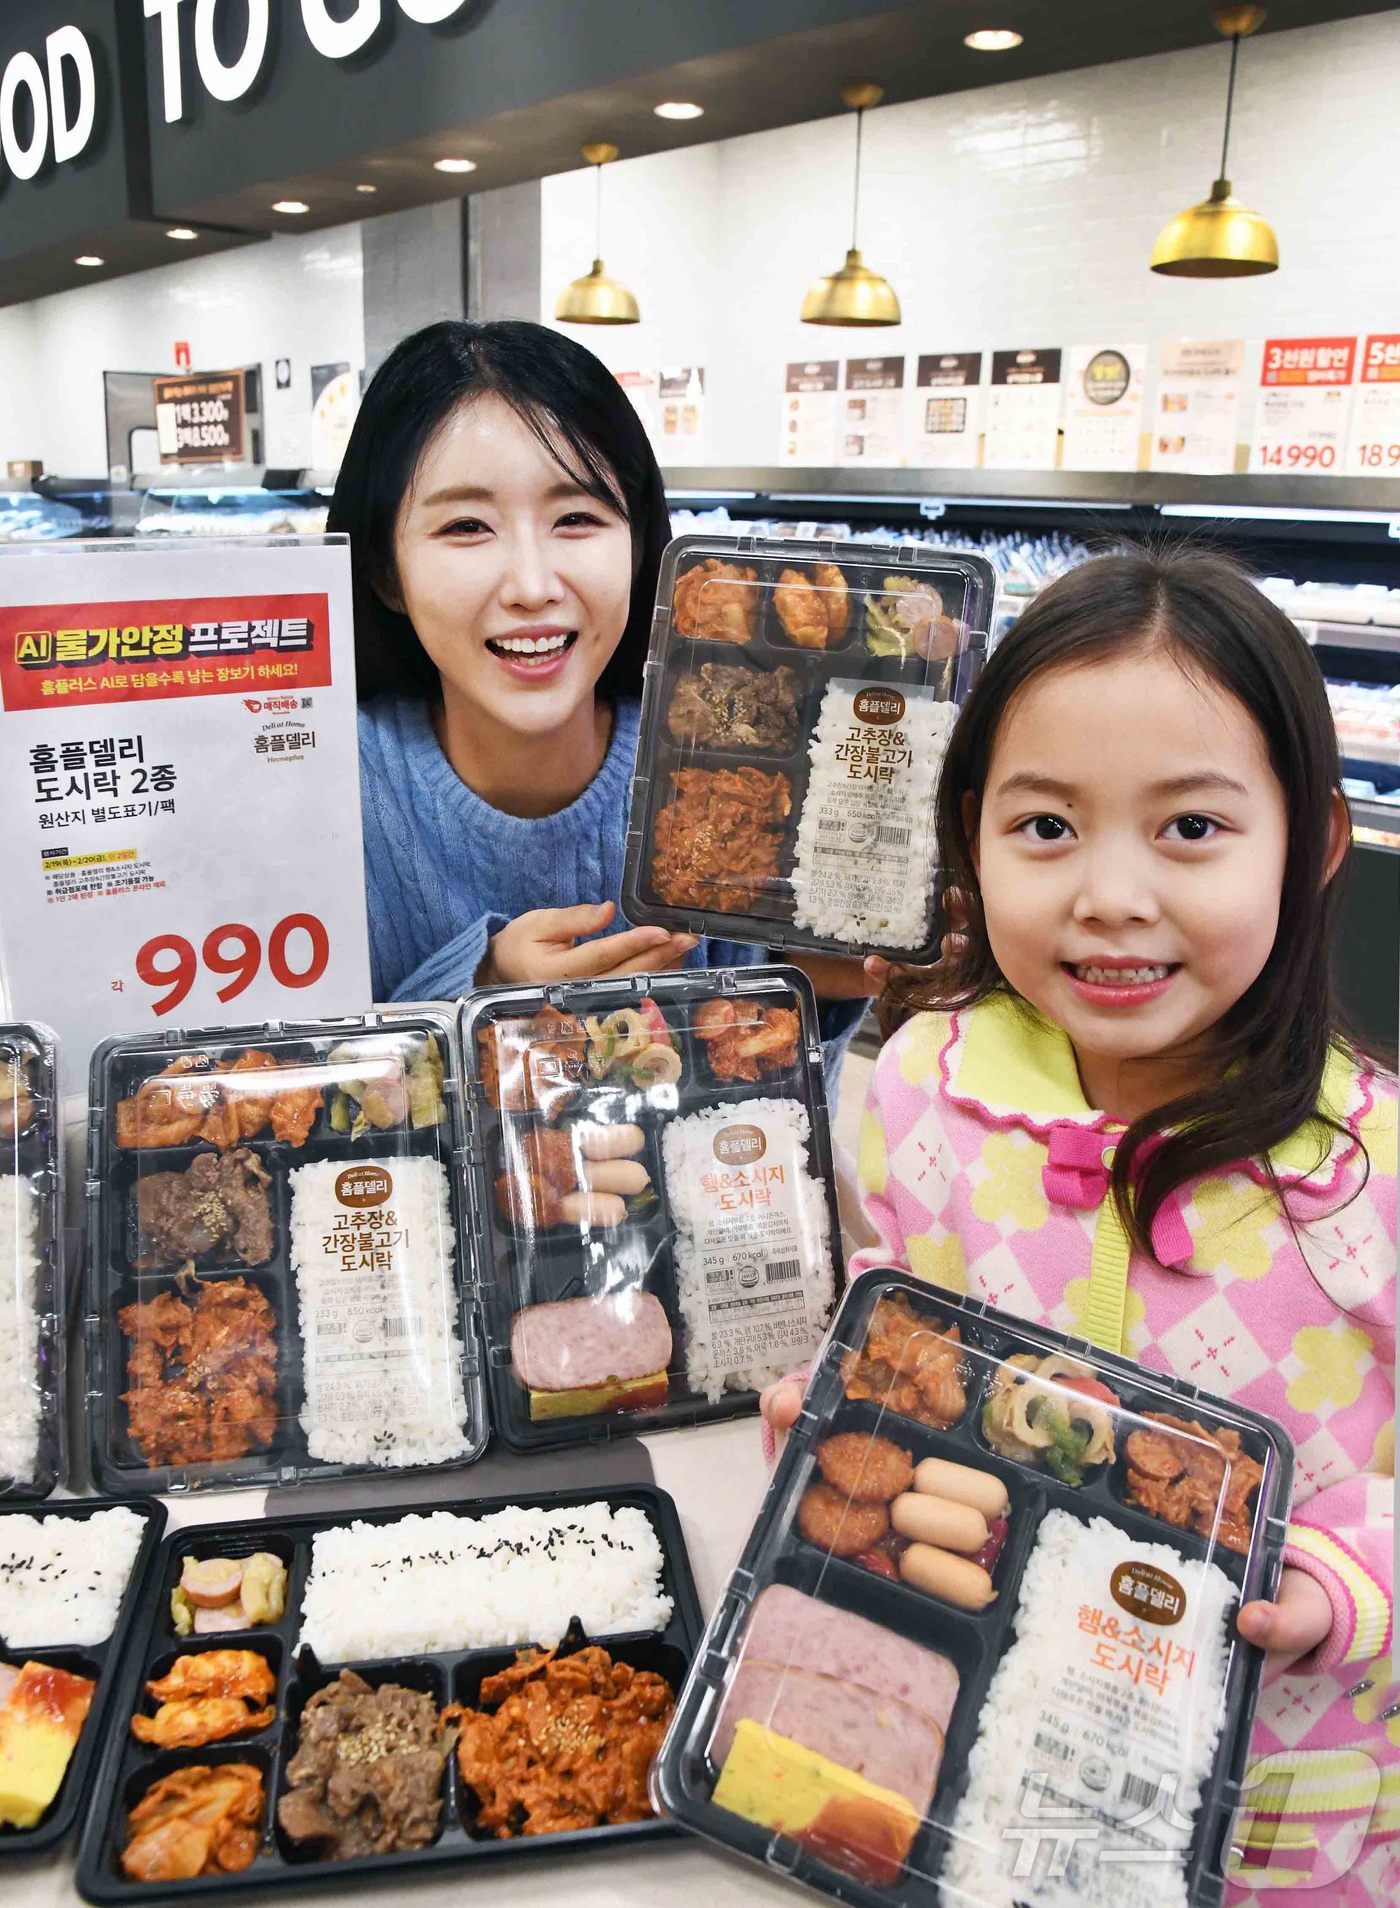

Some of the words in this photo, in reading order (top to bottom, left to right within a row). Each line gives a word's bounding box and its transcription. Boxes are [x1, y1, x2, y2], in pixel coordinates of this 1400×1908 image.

[0, 25, 95, 180] OD
[1260, 444, 1335, 467] 14990
[18, 634, 48, 658] AI
[55, 623, 184, 661] 물가안정
[189, 618, 309, 652] 프로젝트
[41, 676, 98, 696] 홈플러스
[100, 673, 128, 690] AI로
[131, 667, 186, 687] 담을수록
[188, 668, 214, 684] 남는
[216, 664, 256, 682] 장보기
[258, 663, 299, 679] 하세요!
[858, 698, 901, 715] 홈플델리
[254, 731, 316, 754] 홈플델리
[845, 727, 905, 747] 고추장&
[29, 735, 145, 774] 홈플델리
[834, 743, 913, 768] 간장불고기
[35, 769, 121, 803] 도시락
[130, 764, 178, 794] 2종
[847, 764, 895, 784] 도시락
[38, 809, 86, 829] 원산지
[91, 799, 176, 823] 별도표기/팩
[136, 913, 330, 1017] 990
[112, 980, 124, 993] 각
[341, 1180, 387, 1196] 홈플델리
[701, 1165, 784, 1193] 햄&소시지
[720, 1188, 772, 1210] 도시락
[332, 1210, 398, 1231] 고추장&
[322, 1229, 409, 1254] 간장불고기
[340, 1251, 393, 1272] 도시락
[703, 1257, 717, 1266] 345
[718, 1257, 725, 1265] g
[732, 1252, 748, 1262] 670
[1118, 1574, 1180, 1616] 홈플델리
[1078, 1604, 1195, 1679] 햄&소시지
[1090, 1642, 1169, 1696] 도시락
